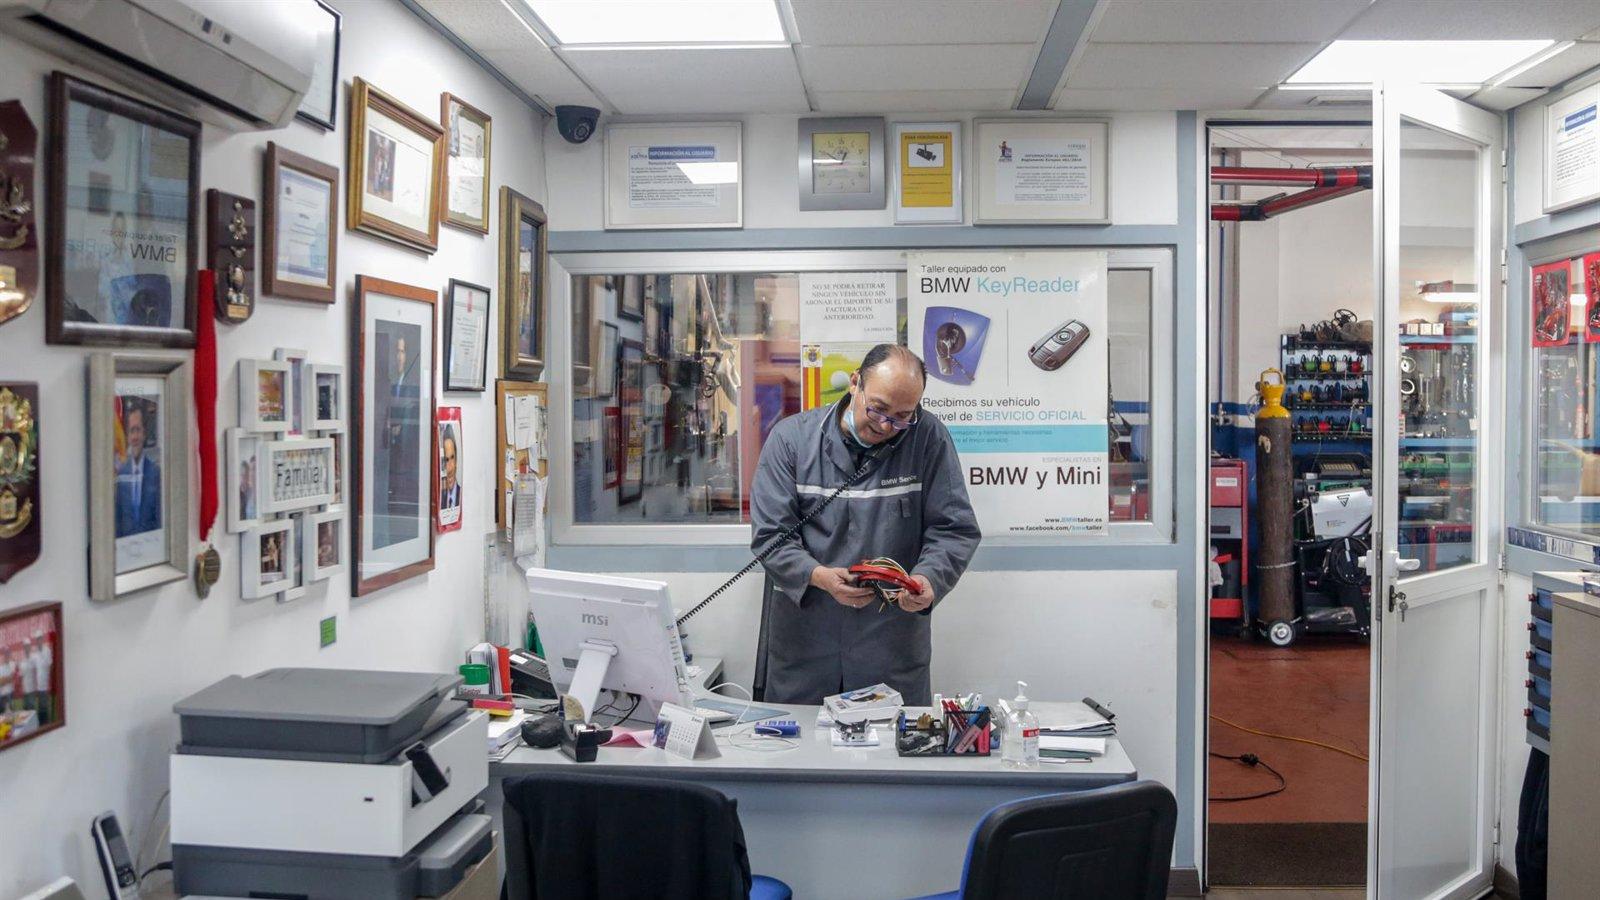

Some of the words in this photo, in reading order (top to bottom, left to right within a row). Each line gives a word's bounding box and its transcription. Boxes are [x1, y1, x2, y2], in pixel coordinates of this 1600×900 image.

[921, 265, 945, 273] Taller
[947, 265, 988, 274] equipado
[920, 277, 971, 294] BMW
[977, 276, 1081, 297] KeyReader
[922, 397, 977, 408] Recibimos
[980, 399, 993, 407] su
[959, 412, 973, 421] de
[975, 410, 1035, 421] SERVICIO
[1038, 410, 1087, 421] OFICIAL
[969, 466, 1029, 486] BMW
[1035, 470, 1049, 490] y
[1056, 465, 1102, 486] Mini
[582, 613, 609, 626] msi
